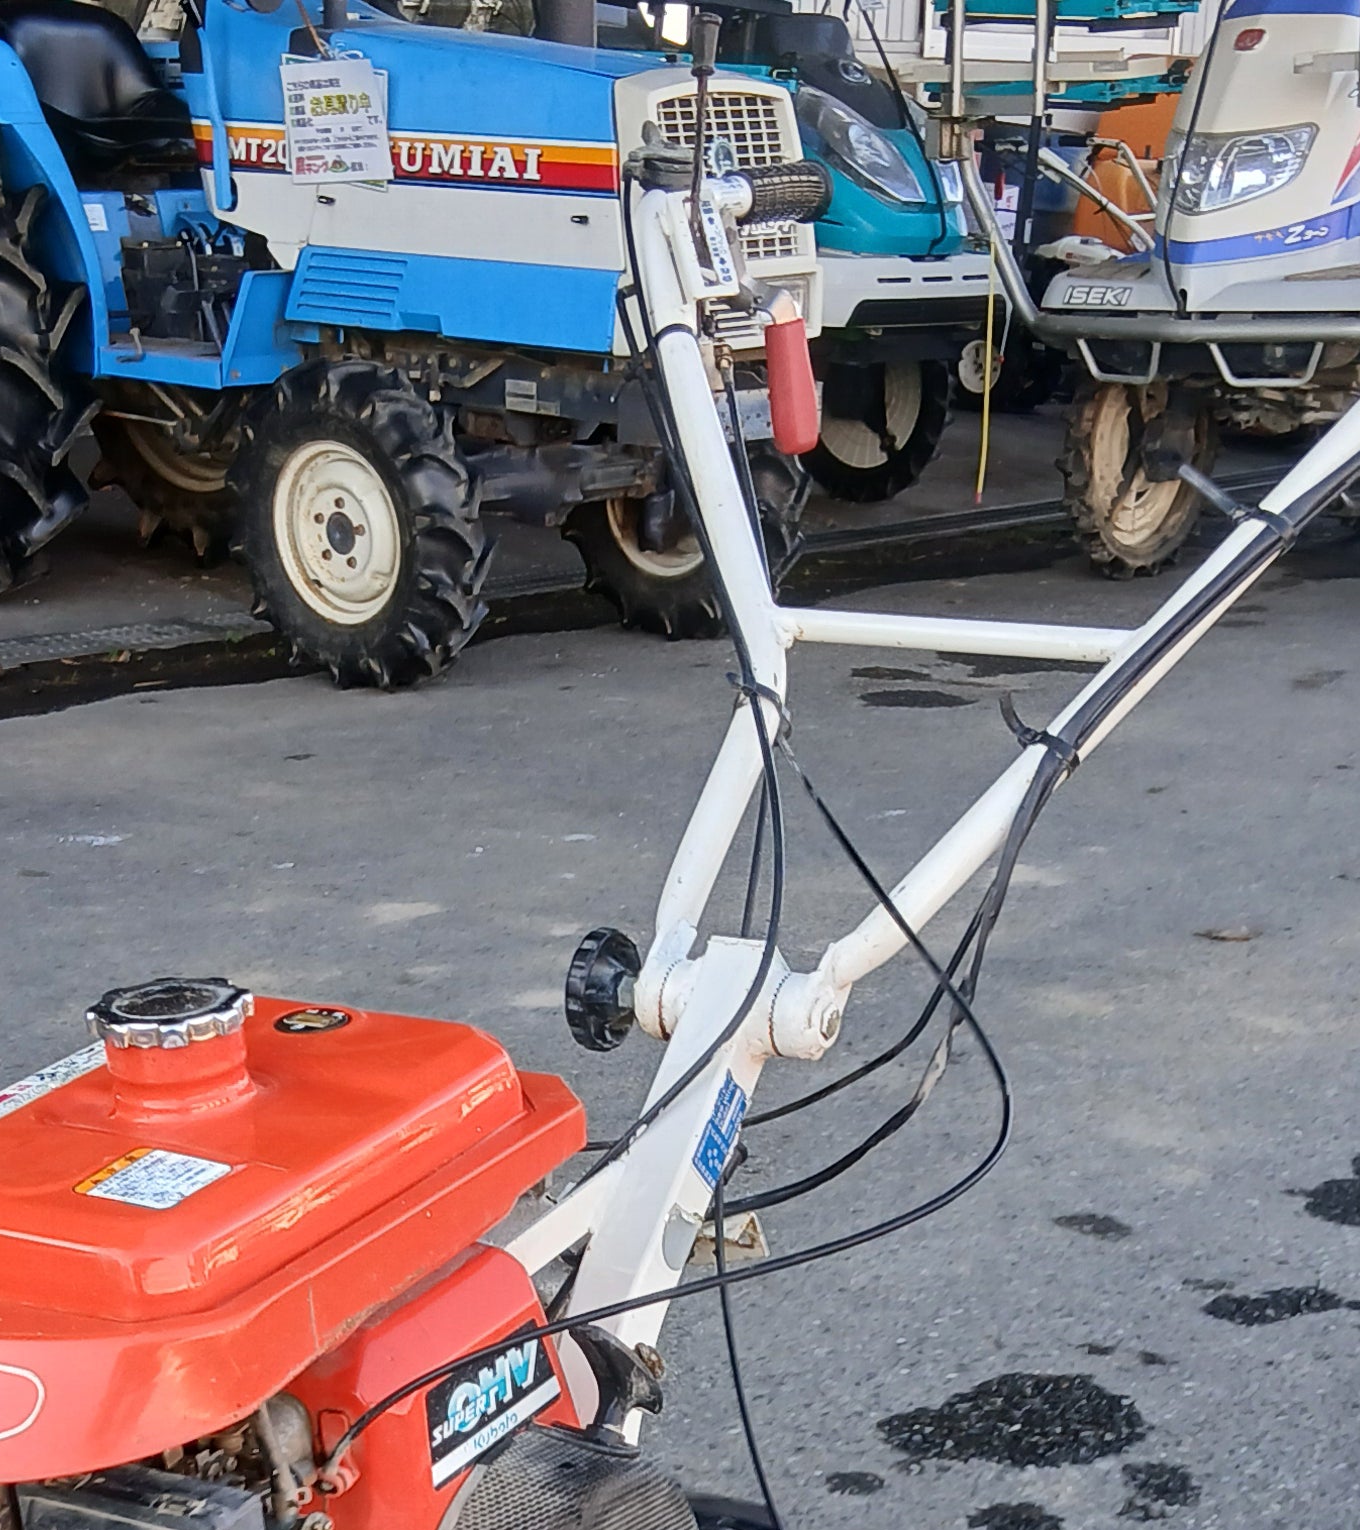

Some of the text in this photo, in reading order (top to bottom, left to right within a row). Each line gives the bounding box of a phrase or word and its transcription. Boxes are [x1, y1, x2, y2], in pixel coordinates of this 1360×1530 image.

[391, 141, 542, 180] UMIAI
[1063, 285, 1133, 306] ISEKI
[432, 1394, 487, 1447] SUPER
[473, 1411, 518, 1449] Kubota
